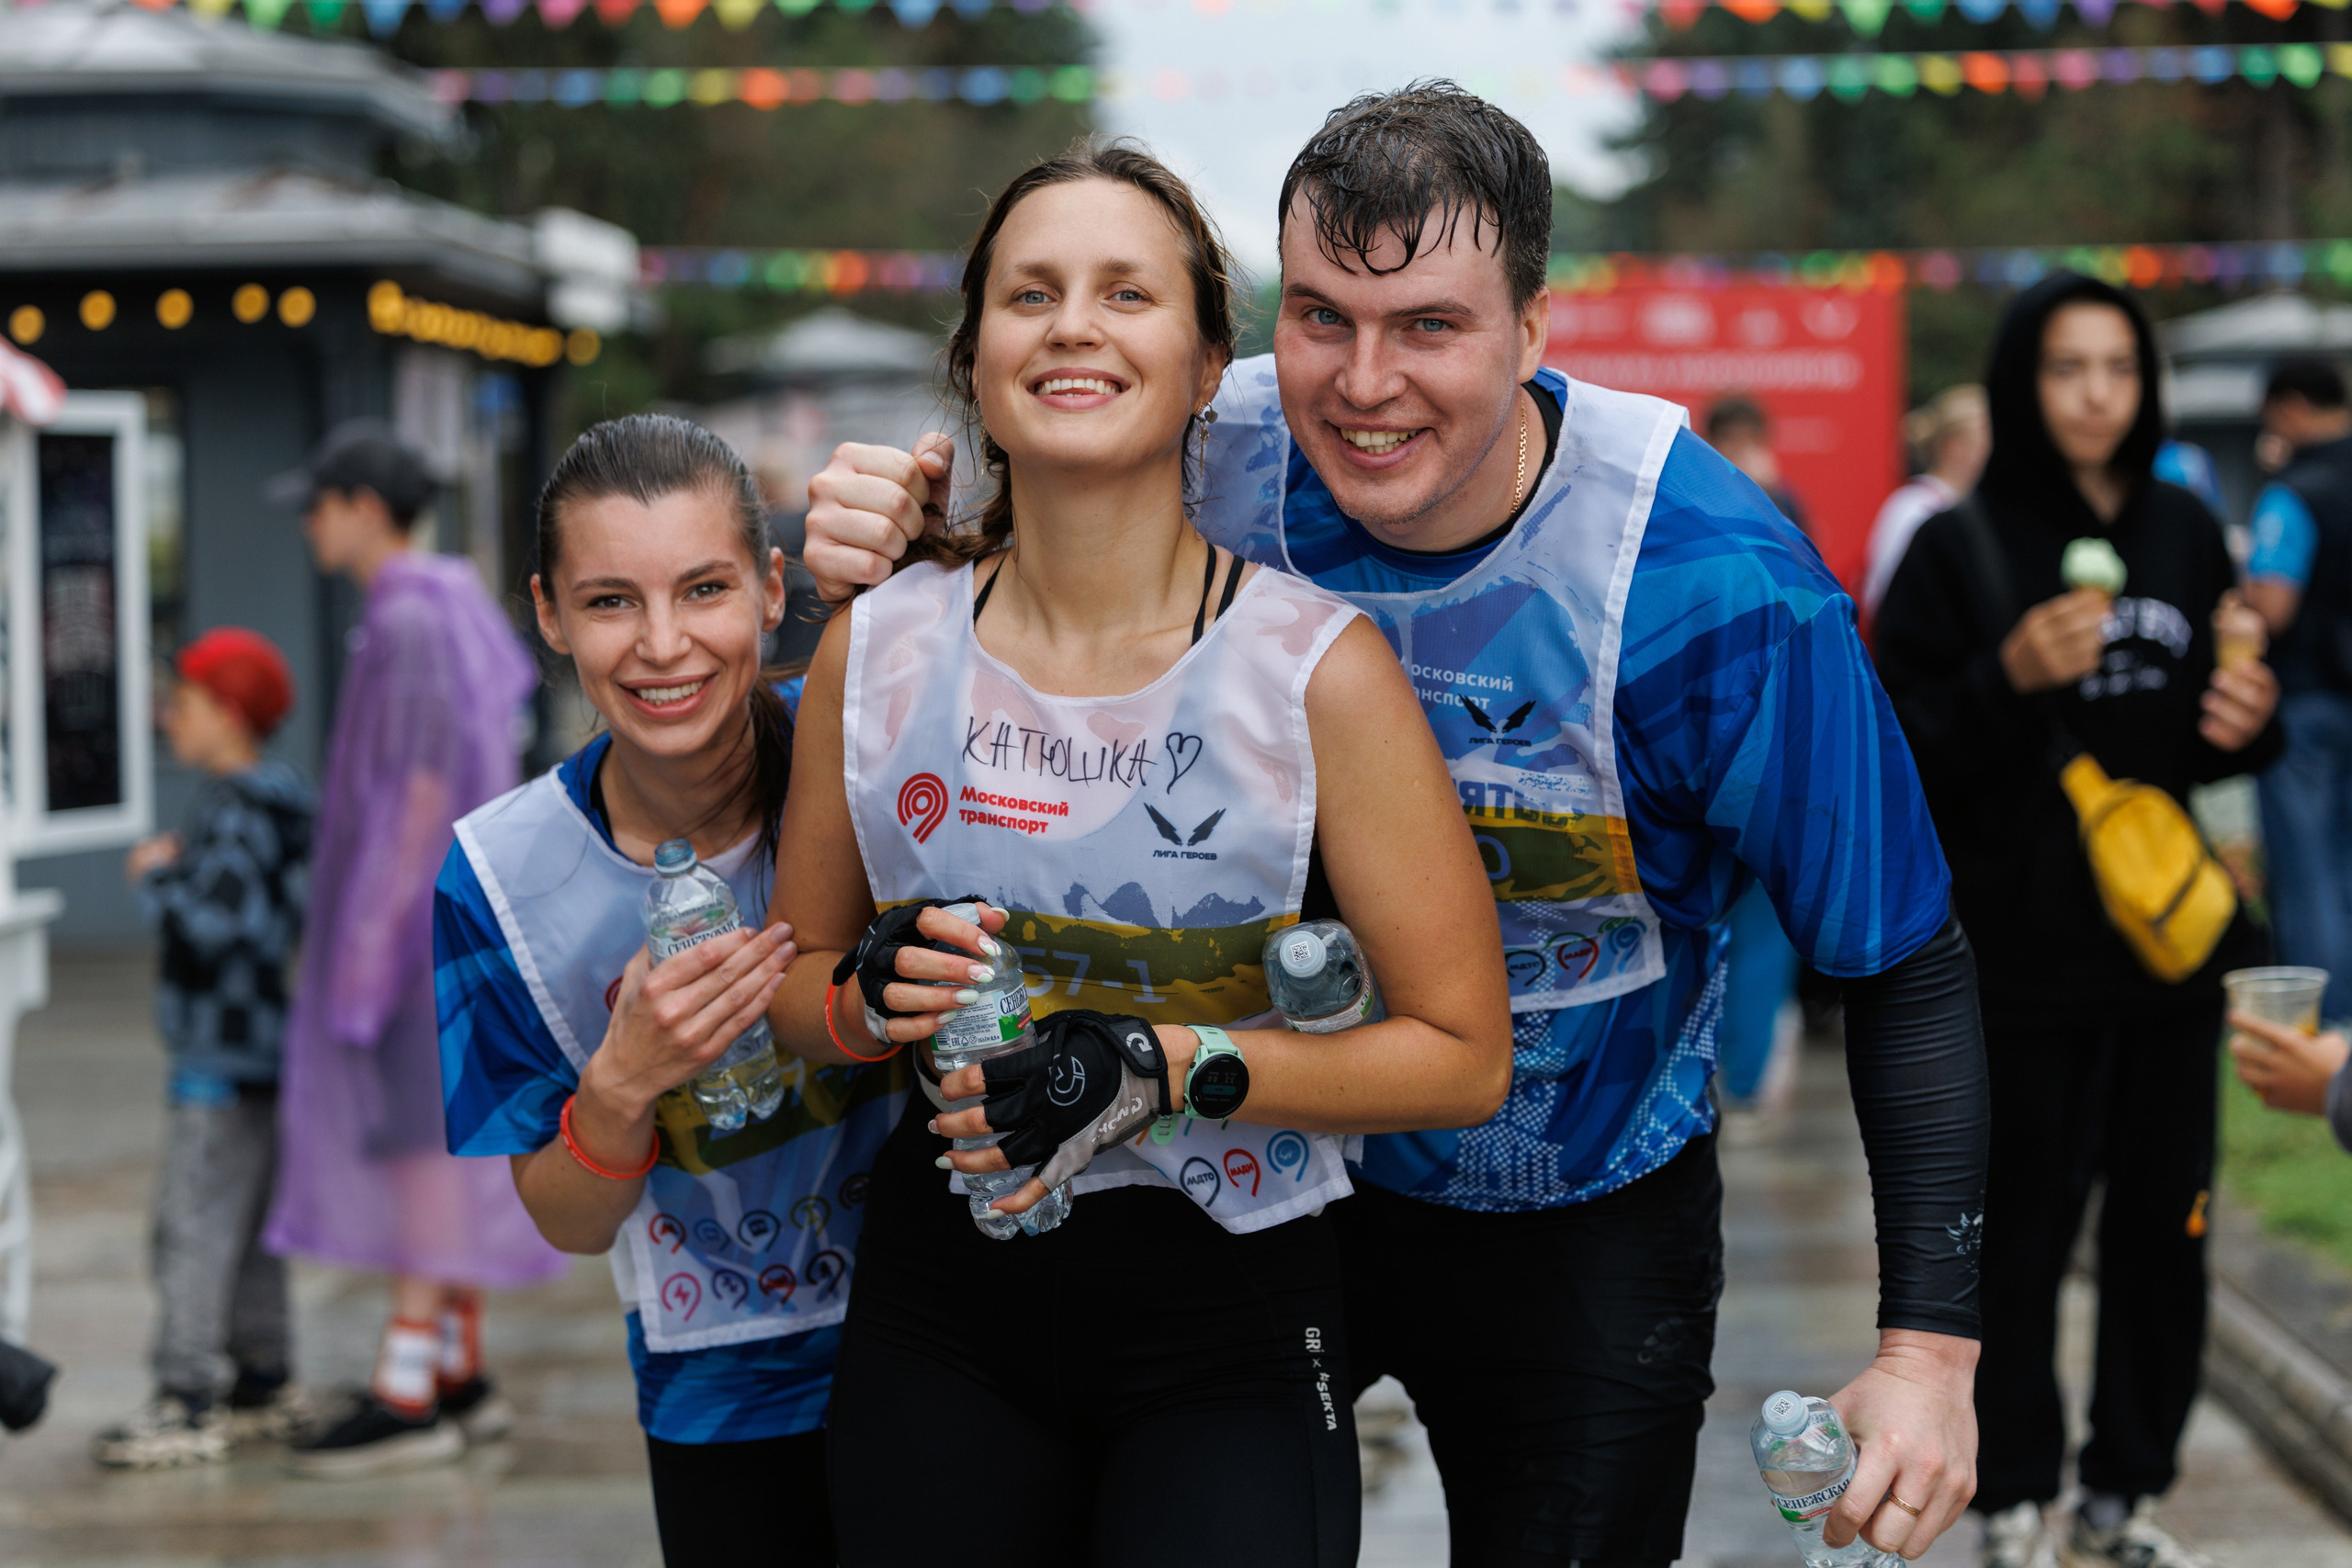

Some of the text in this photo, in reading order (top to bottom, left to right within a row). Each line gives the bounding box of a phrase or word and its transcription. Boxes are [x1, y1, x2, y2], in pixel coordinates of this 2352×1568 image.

[1407, 663, 1514, 693] осковский
[962, 716, 1159, 788] КАТЮШКА
[959, 785, 1069, 817] Московский
[959, 808, 1049, 834] транспорт
[1152, 850, 1217, 861] ЛИГА ГЕРОЕВ
[1186, 1172, 1215, 1186] МДТО
[1229, 1163, 1254, 1177] МАДИ
